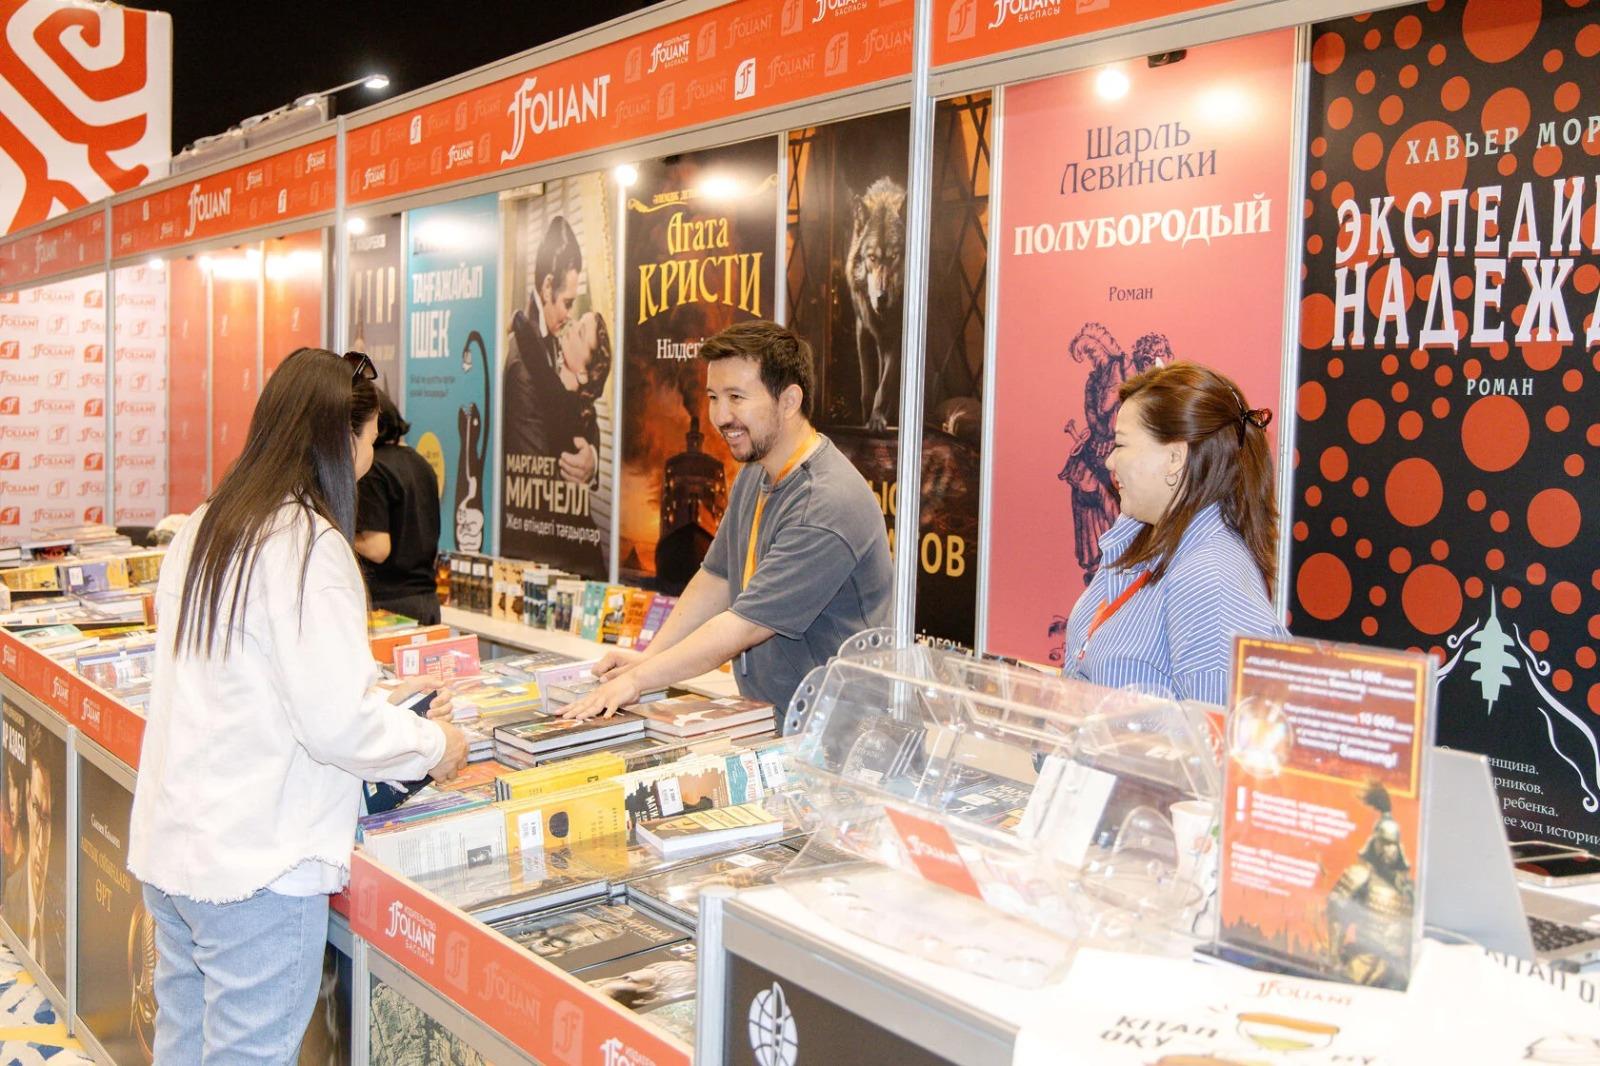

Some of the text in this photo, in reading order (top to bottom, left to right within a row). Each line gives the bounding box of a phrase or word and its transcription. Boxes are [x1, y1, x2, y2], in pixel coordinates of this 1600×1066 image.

[1018, 7, 1061, 23] БАСПАСЫ
[647, 40, 691, 74] FOLIANT
[500, 74, 611, 165] FOLIANT
[1086, 121, 1191, 163] Шарль
[1405, 127, 1520, 165] ХАВЬЕР
[1060, 149, 1217, 195] Левински
[184, 183, 232, 238] FOLIANT
[1012, 192, 1273, 257] ПОЛУБОРОДЫЙ
[667, 211, 729, 255] Агата
[638, 252, 764, 326] КРИСТИ
[1108, 286, 1154, 302] Роман
[1466, 378, 1535, 397] РОМАН
[505, 453, 557, 477] МАРГАРЕТ
[505, 475, 590, 517] МИТЧЕЛЛ
[505, 512, 523, 530] Жел
[1503, 797, 1559, 817] ребенка.
[1520, 819, 1543, 834] ход
[385, 900, 437, 954] FOLIANT
